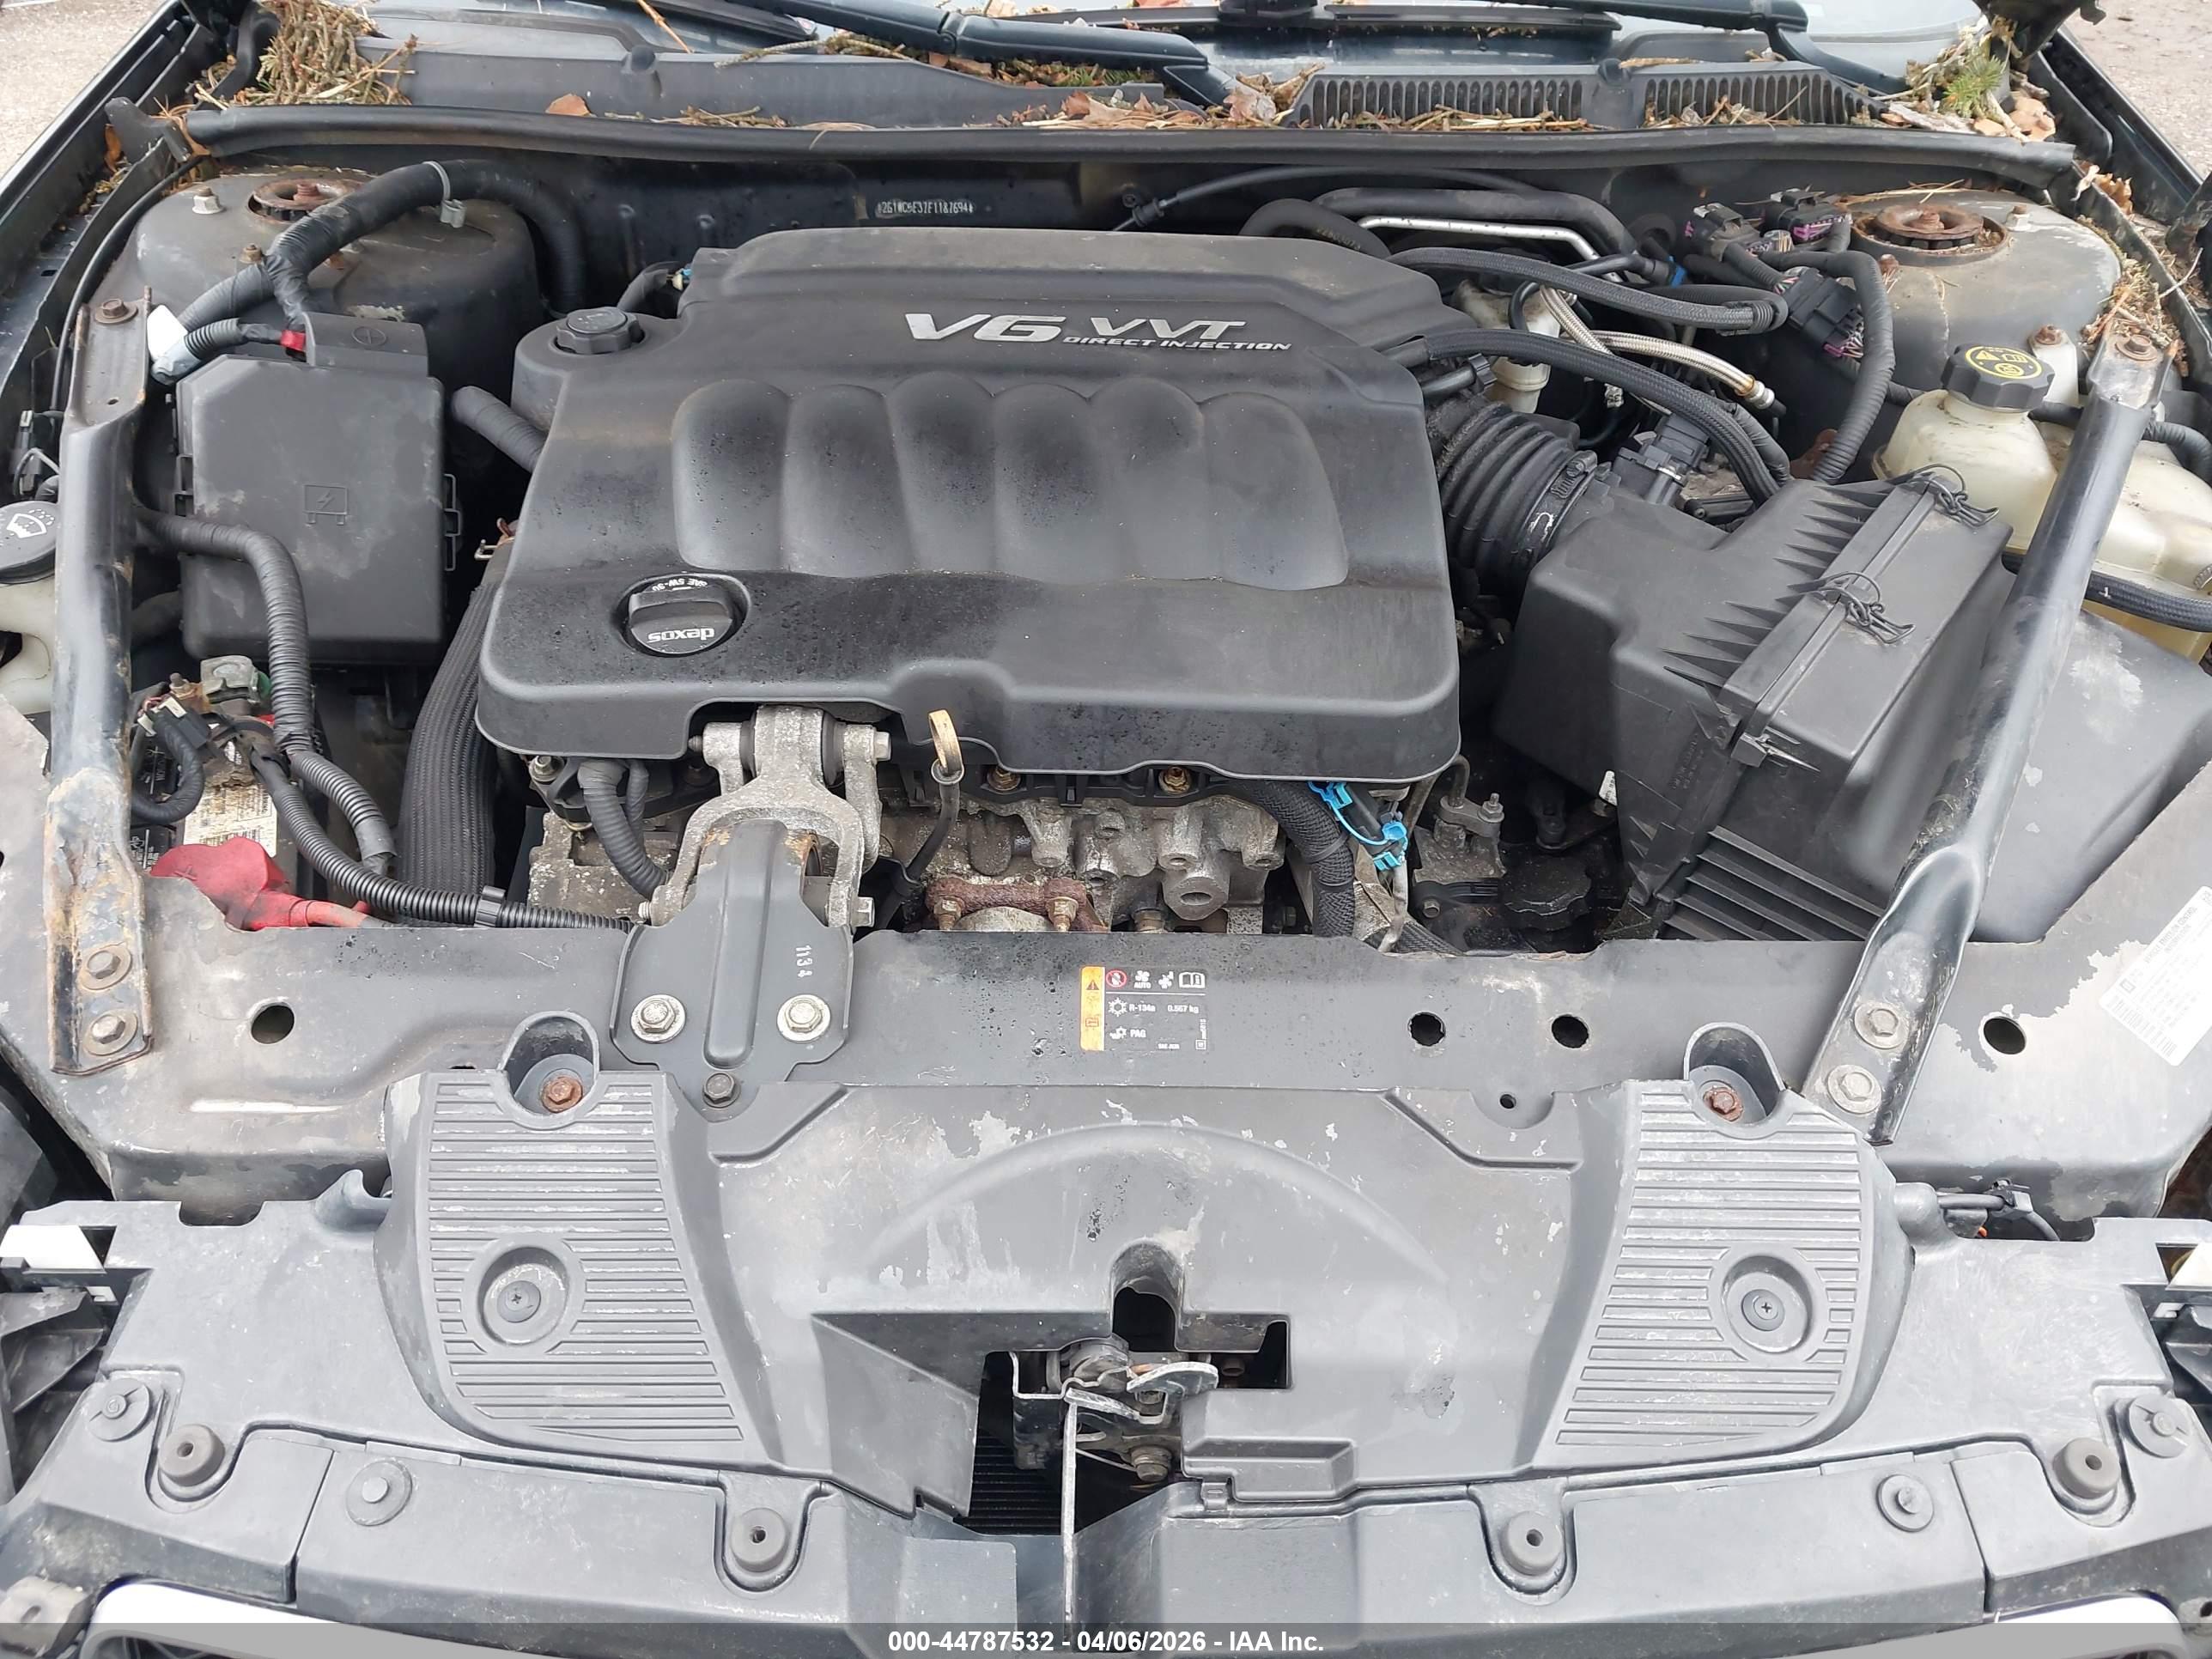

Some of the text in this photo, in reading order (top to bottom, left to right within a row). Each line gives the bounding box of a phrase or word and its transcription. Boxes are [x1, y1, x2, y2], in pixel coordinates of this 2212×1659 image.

[904, 313, 1246, 343] V6 VVT
[1063, 336, 1292, 351] DIRECT INJECTION
[687, 578, 708, 588] SAE
[647, 628, 714, 643] dexos
[1188, 1004, 1200, 1014] kg
[1129, 1029, 1147, 1038] PAG
